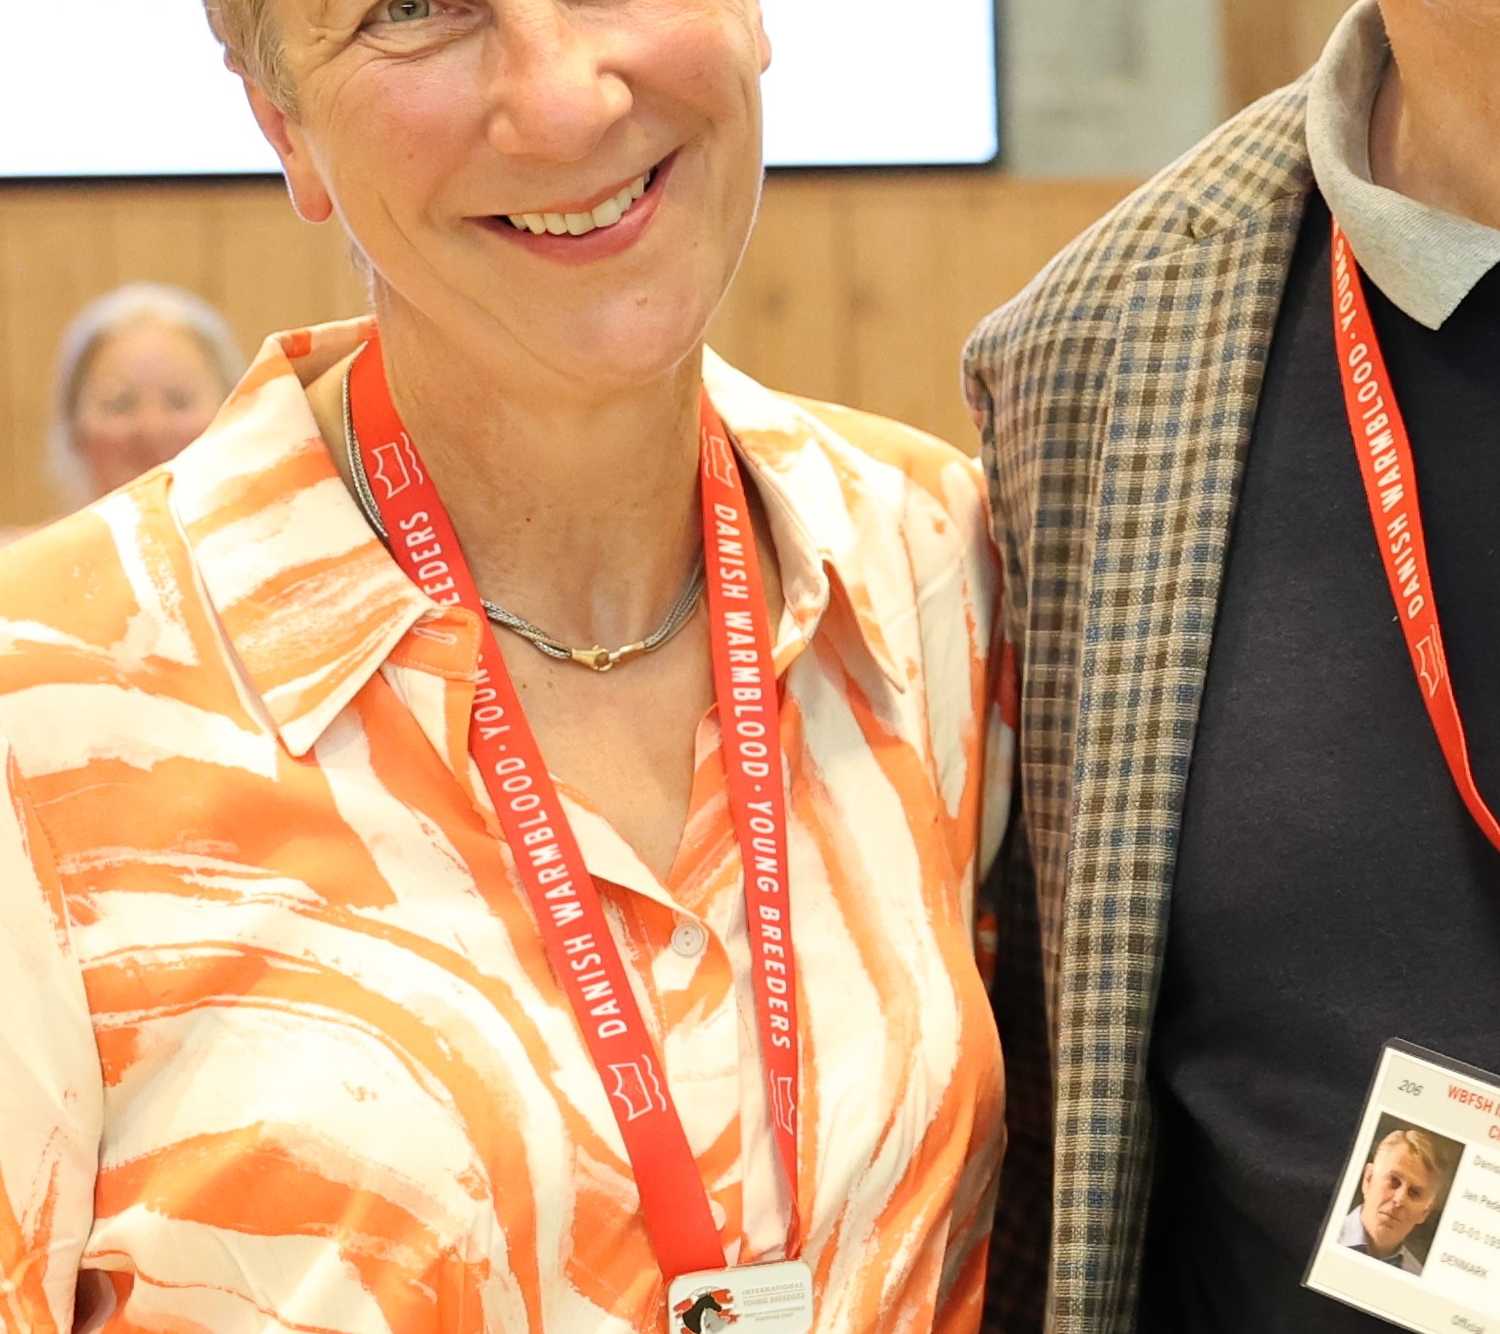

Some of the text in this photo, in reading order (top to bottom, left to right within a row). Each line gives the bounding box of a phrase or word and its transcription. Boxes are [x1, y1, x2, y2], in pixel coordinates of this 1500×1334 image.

[1348, 341, 1405, 514] WARMBLOOD
[399, 511, 461, 608] EEDERS
[1386, 511, 1425, 619] DANISH
[714, 503, 791, 1049] DANISH WARMBLOOD YOUNG BREEDERS
[495, 757, 585, 927] WARMBLOOD
[563, 932, 628, 1039] DANISH
[1398, 1080, 1424, 1097] 206
[1448, 1084, 1492, 1113] WBFSH
